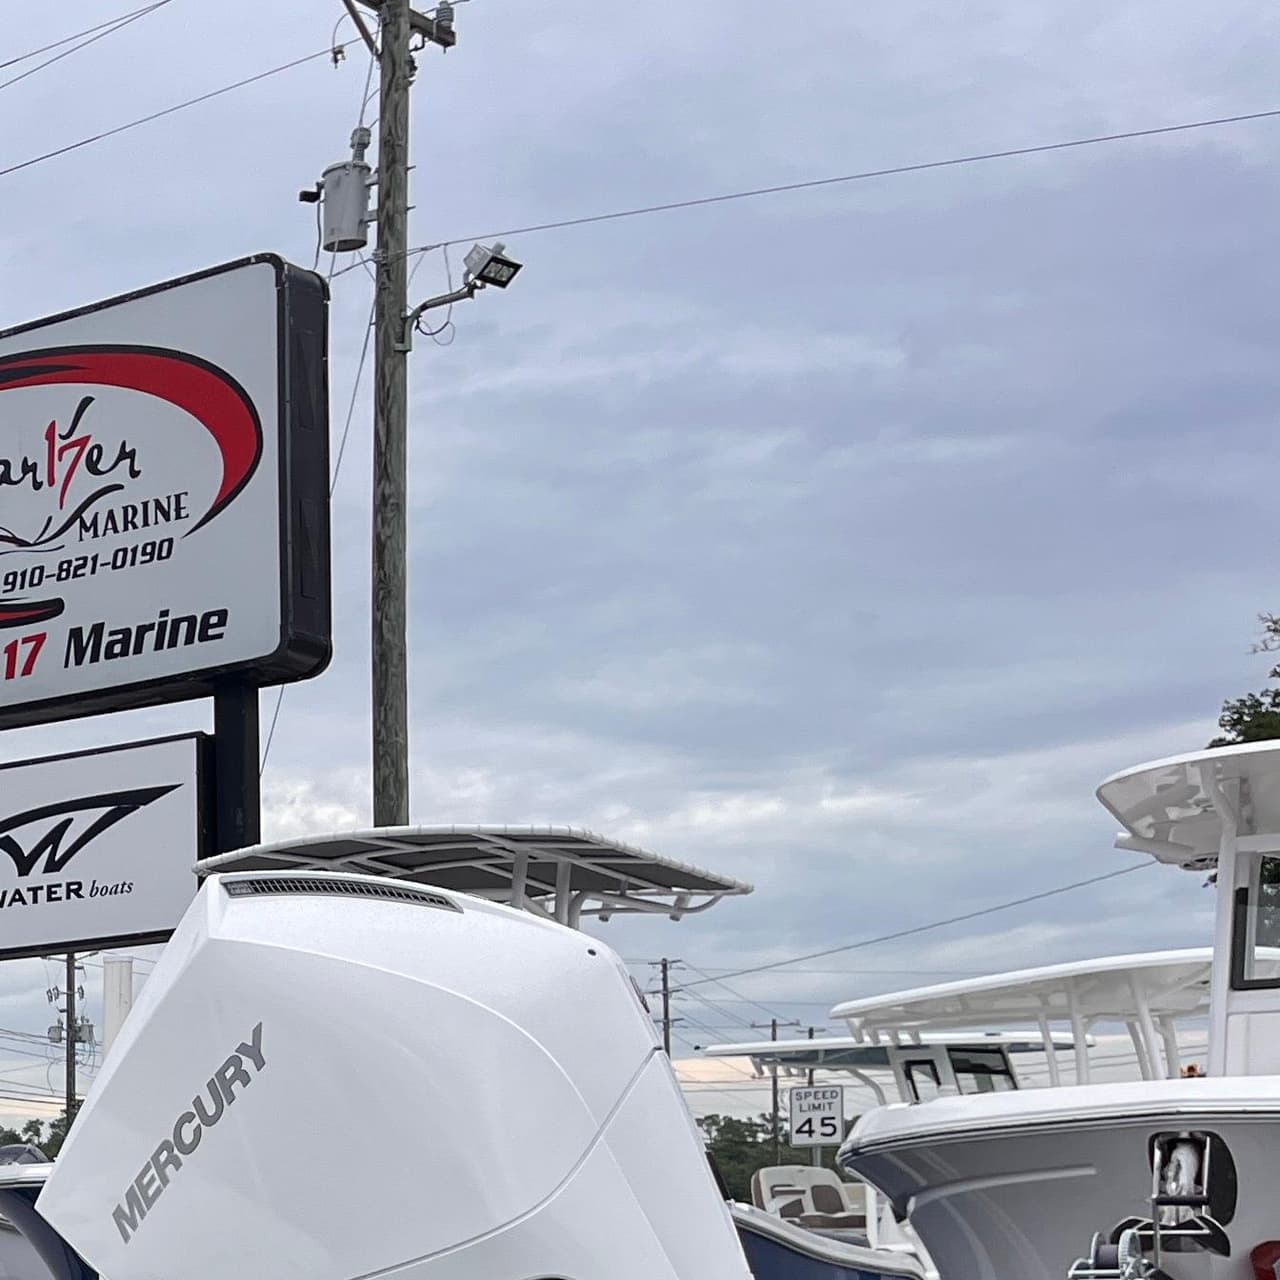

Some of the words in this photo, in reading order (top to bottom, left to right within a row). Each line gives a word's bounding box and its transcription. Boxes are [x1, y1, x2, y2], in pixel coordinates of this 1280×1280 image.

[78, 492, 189, 541] MARINE
[2, 538, 174, 593] 910-821-0190
[4, 632, 47, 680] 17
[64, 608, 229, 668] Marine
[89, 880, 134, 897] boats
[795, 1090, 839, 1101] SPEED
[799, 1102, 834, 1113] LIMIT
[112, 1021, 266, 1244] MERCURY
[795, 1116, 837, 1138] 45
